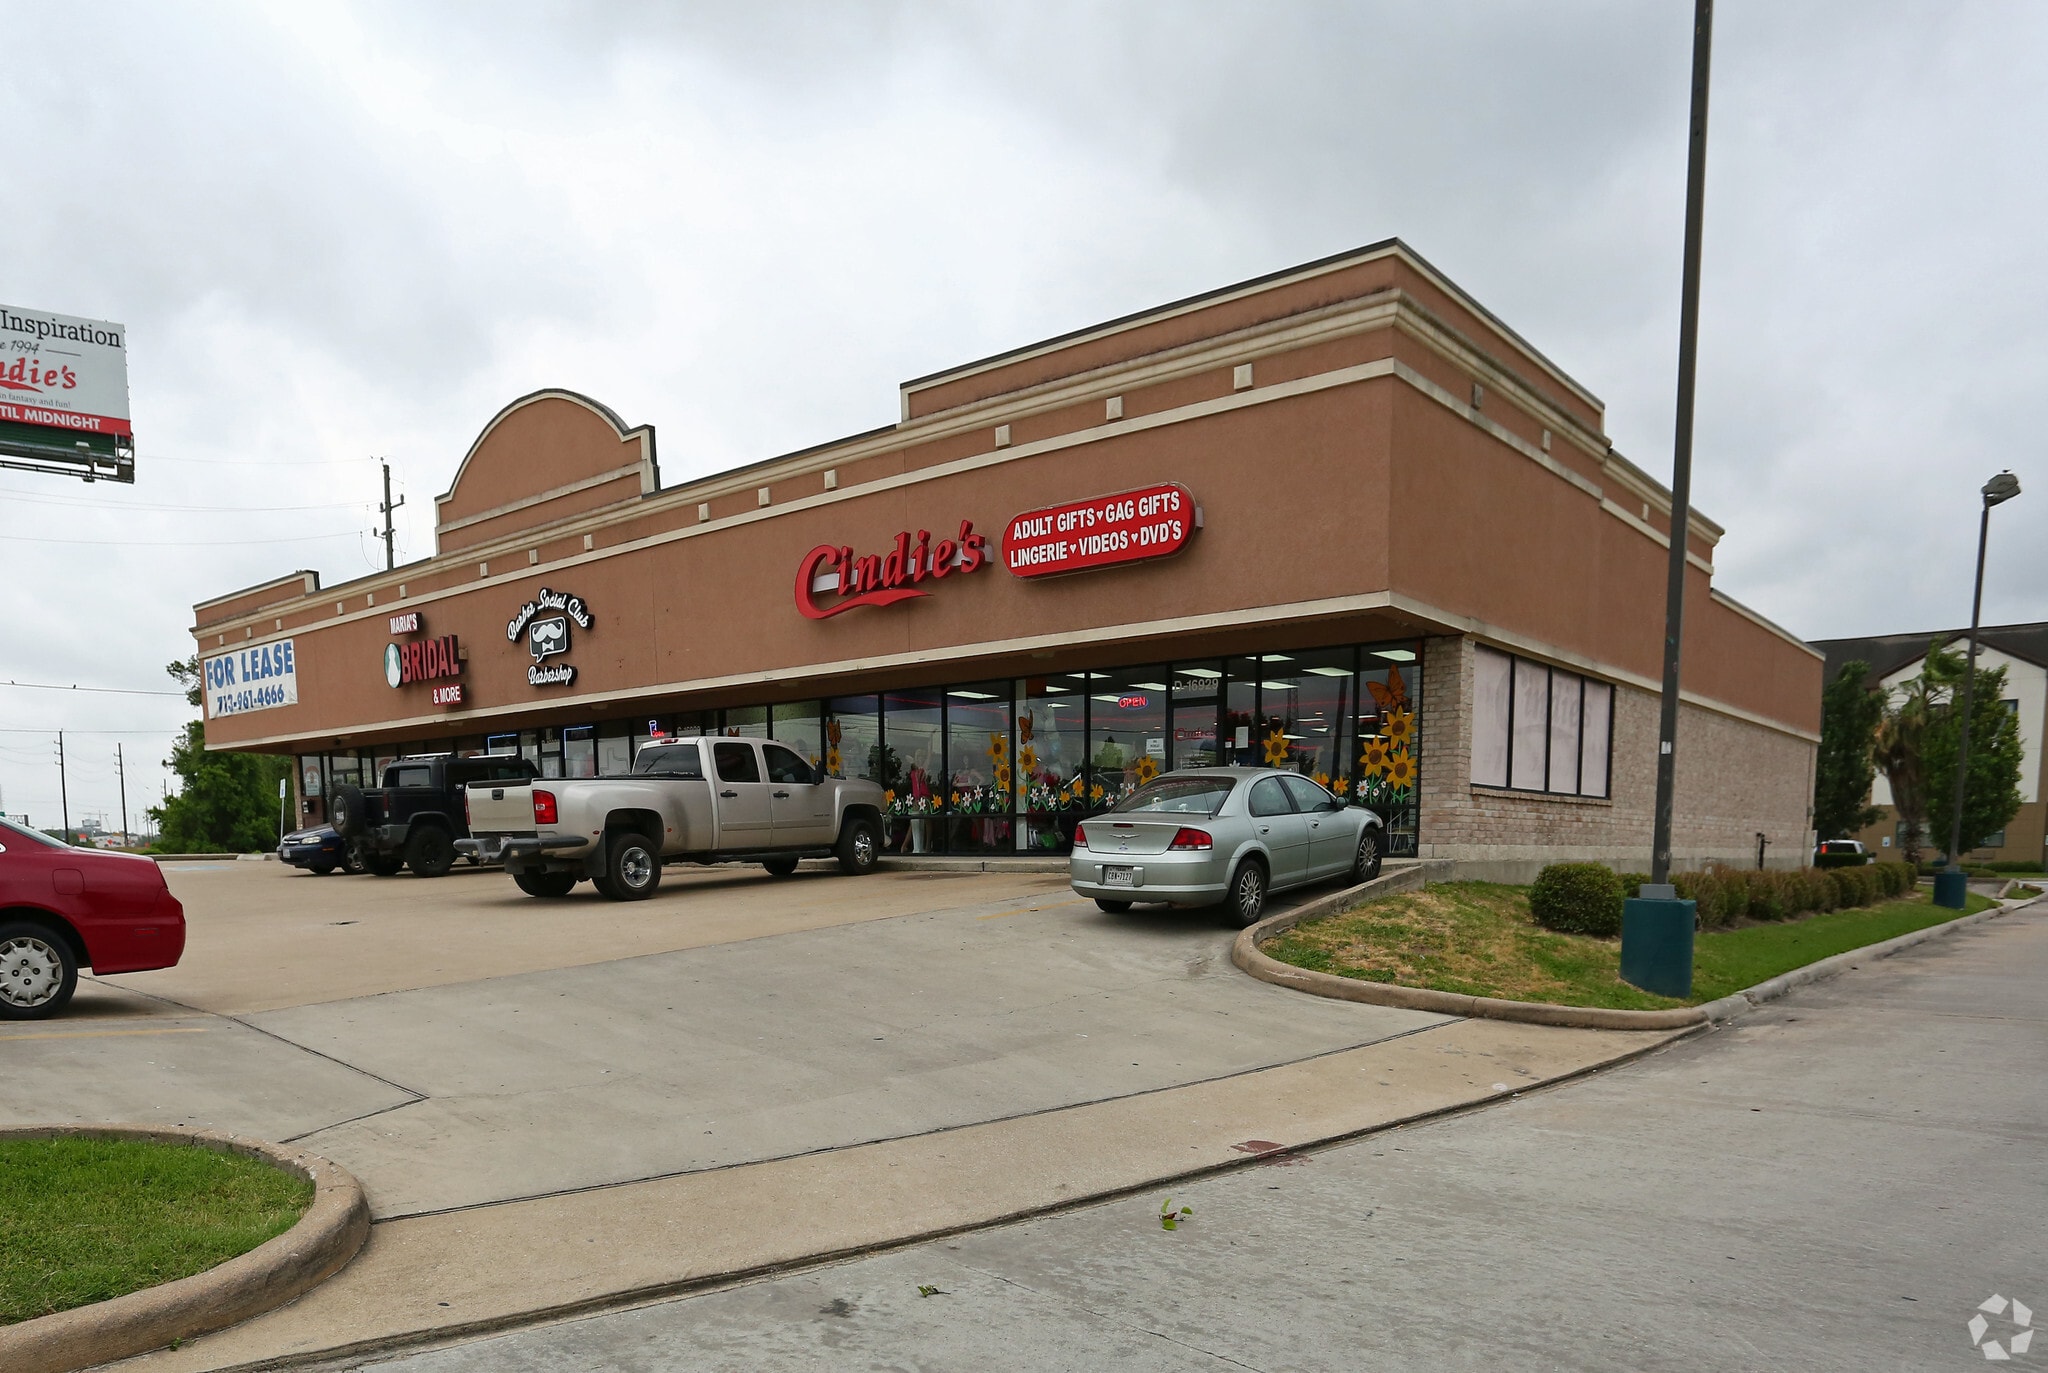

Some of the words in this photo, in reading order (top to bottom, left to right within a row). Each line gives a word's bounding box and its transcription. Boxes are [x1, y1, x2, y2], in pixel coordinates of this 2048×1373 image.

[0, 309, 121, 348] Inspiration
[11, 340, 40, 355] 1994
[24, 408, 101, 430] MIDNIGHT
[1013, 516, 1054, 541] ADULT
[1057, 508, 1096, 533] GIFTS
[1105, 500, 1135, 524] GAG
[1138, 491, 1180, 517] GIFTS
[1010, 541, 1068, 568] LINGERIE
[1078, 530, 1129, 556] VIDEOS
[1140, 519, 1182, 546] DVD'S
[794, 520, 987, 620] Cindie's
[389, 613, 418, 635] MARIA'S
[537, 588, 568, 610] Social
[567, 598, 590, 628] Club
[205, 655, 236, 691] FOR
[241, 642, 294, 683] LEASE
[400, 634, 460, 683] BRIDAL
[528, 664, 573, 686] Barbershop
[217, 684, 285, 714] 713-961-4666
[433, 689, 439, 704] &
[440, 686, 461, 703] MORE
[1118, 696, 1147, 708] OPEN
